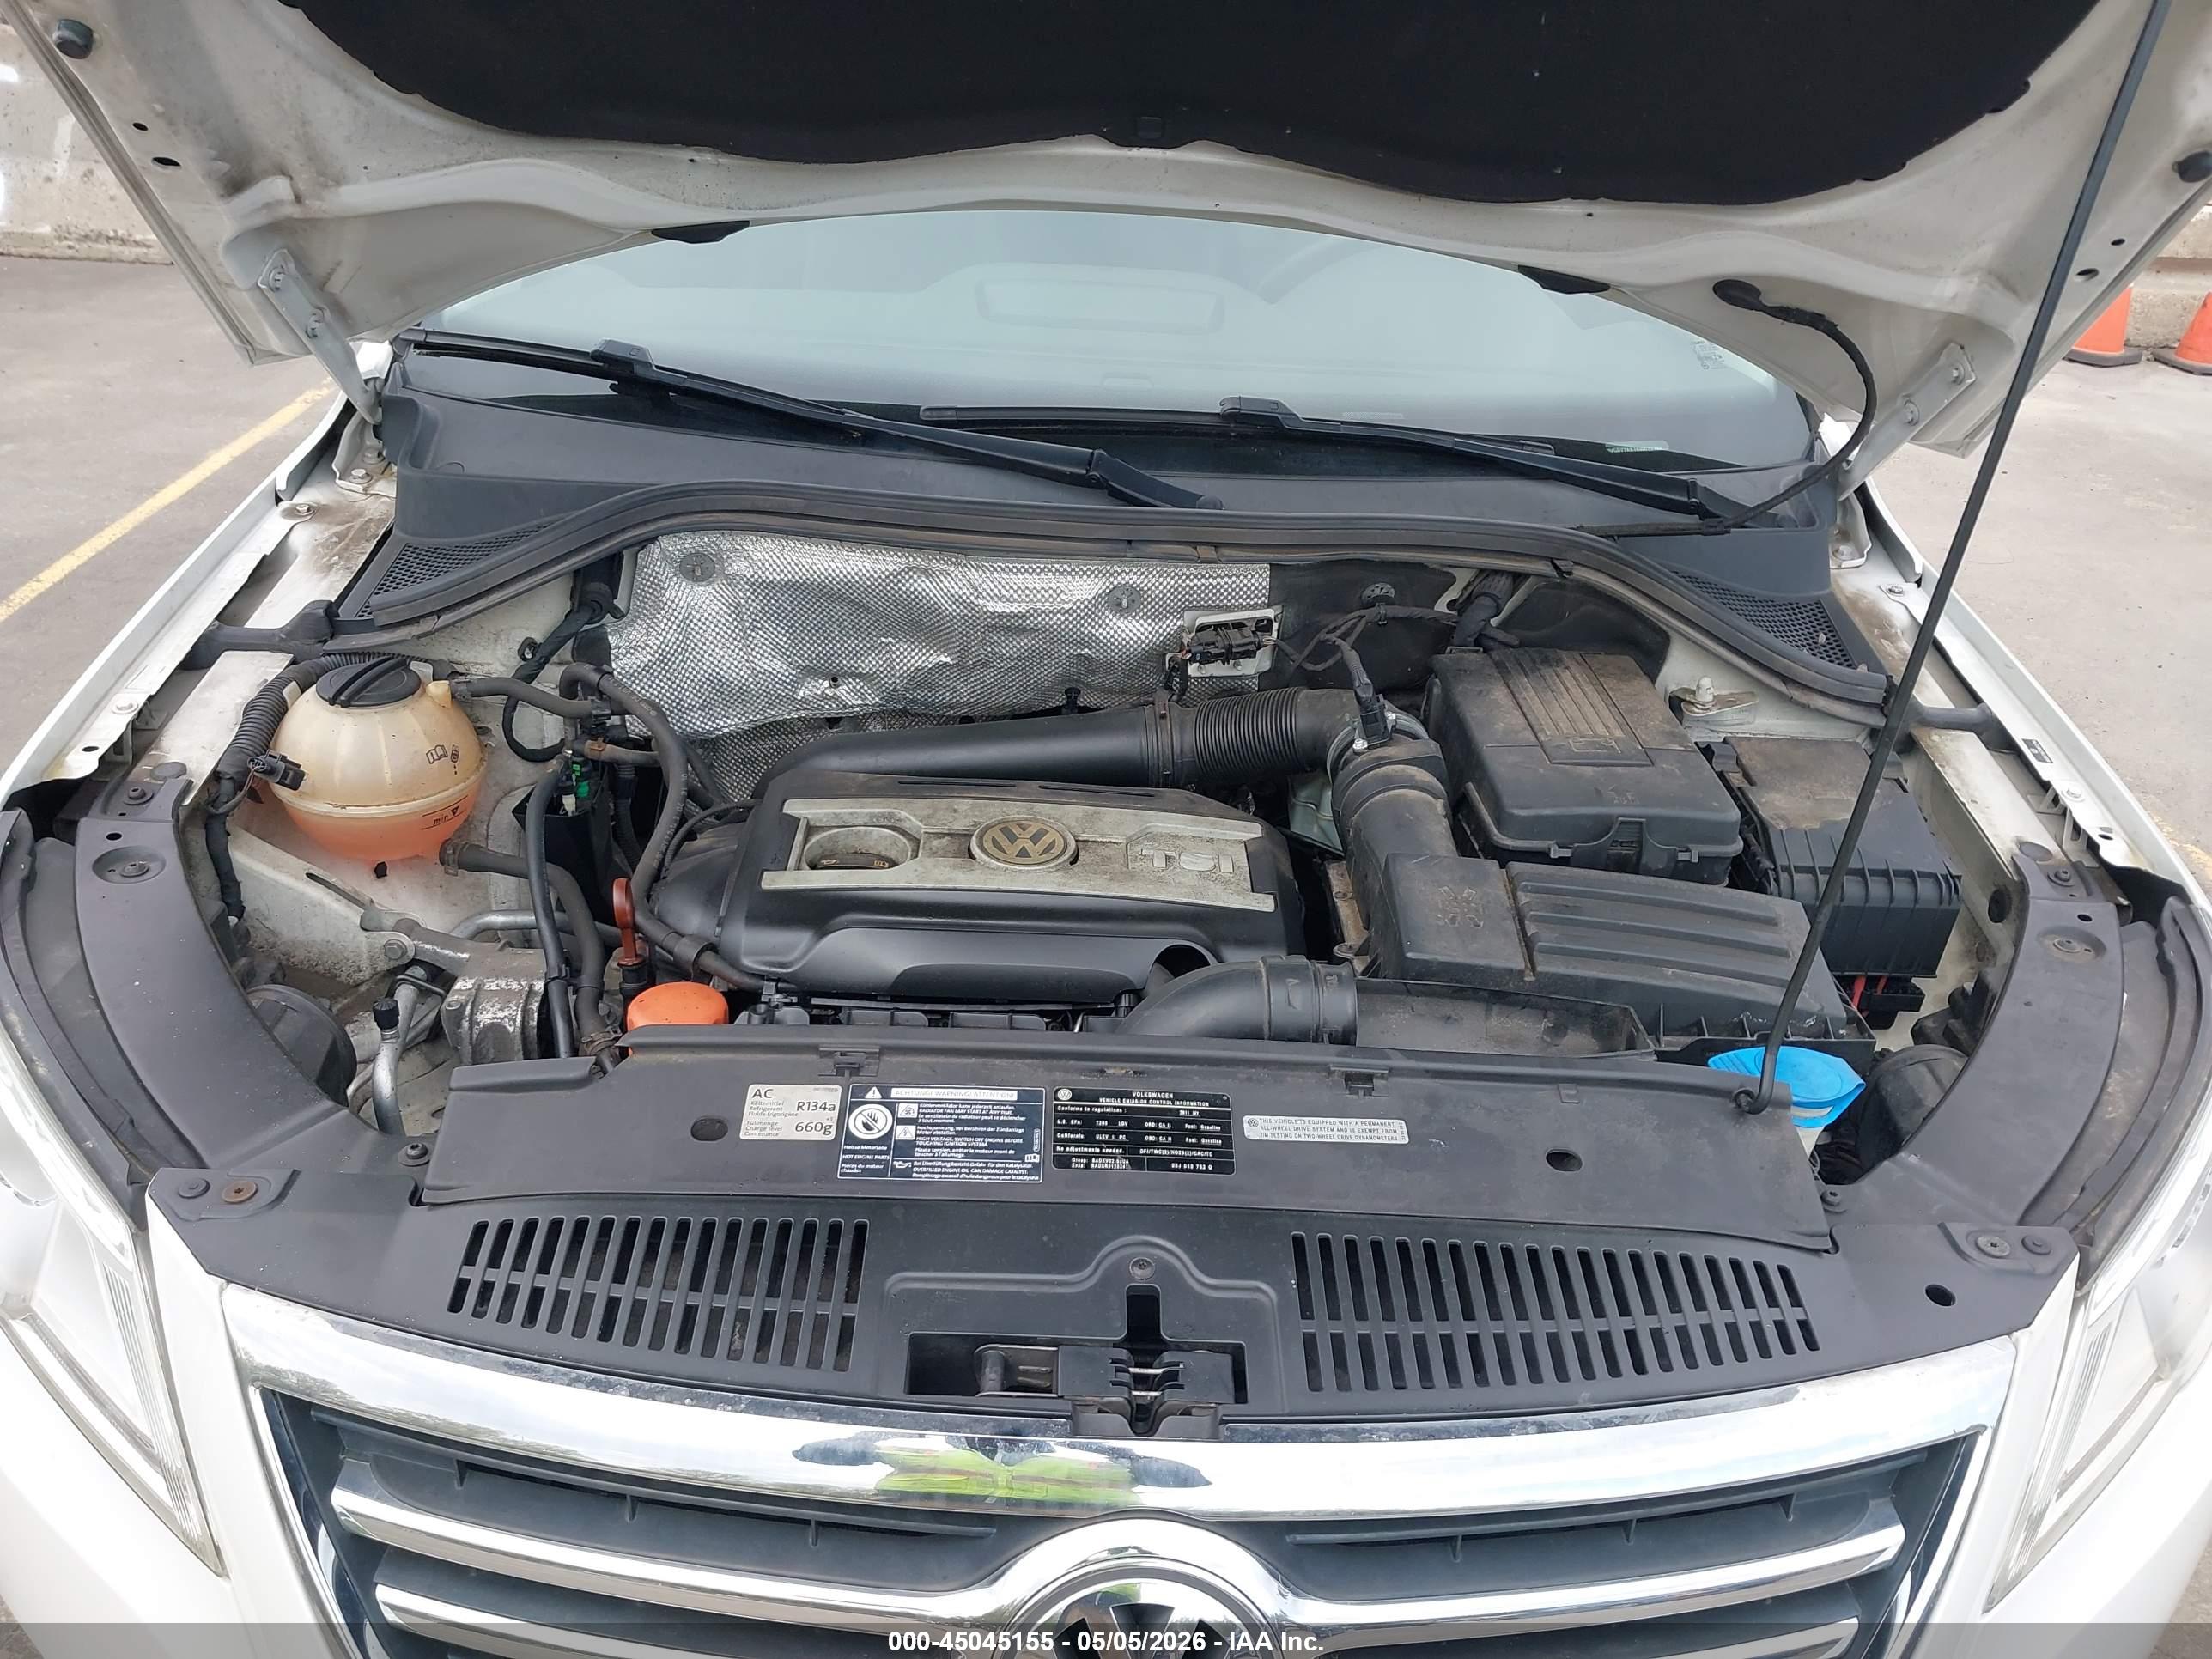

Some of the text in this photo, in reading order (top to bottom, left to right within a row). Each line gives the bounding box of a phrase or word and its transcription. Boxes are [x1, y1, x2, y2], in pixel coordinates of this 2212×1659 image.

[433, 814, 448, 825] min
[1139, 848, 1235, 875] TSI
[752, 1089, 773, 1099] AC
[797, 1101, 836, 1112] R134a
[795, 1121, 833, 1135] 660g
